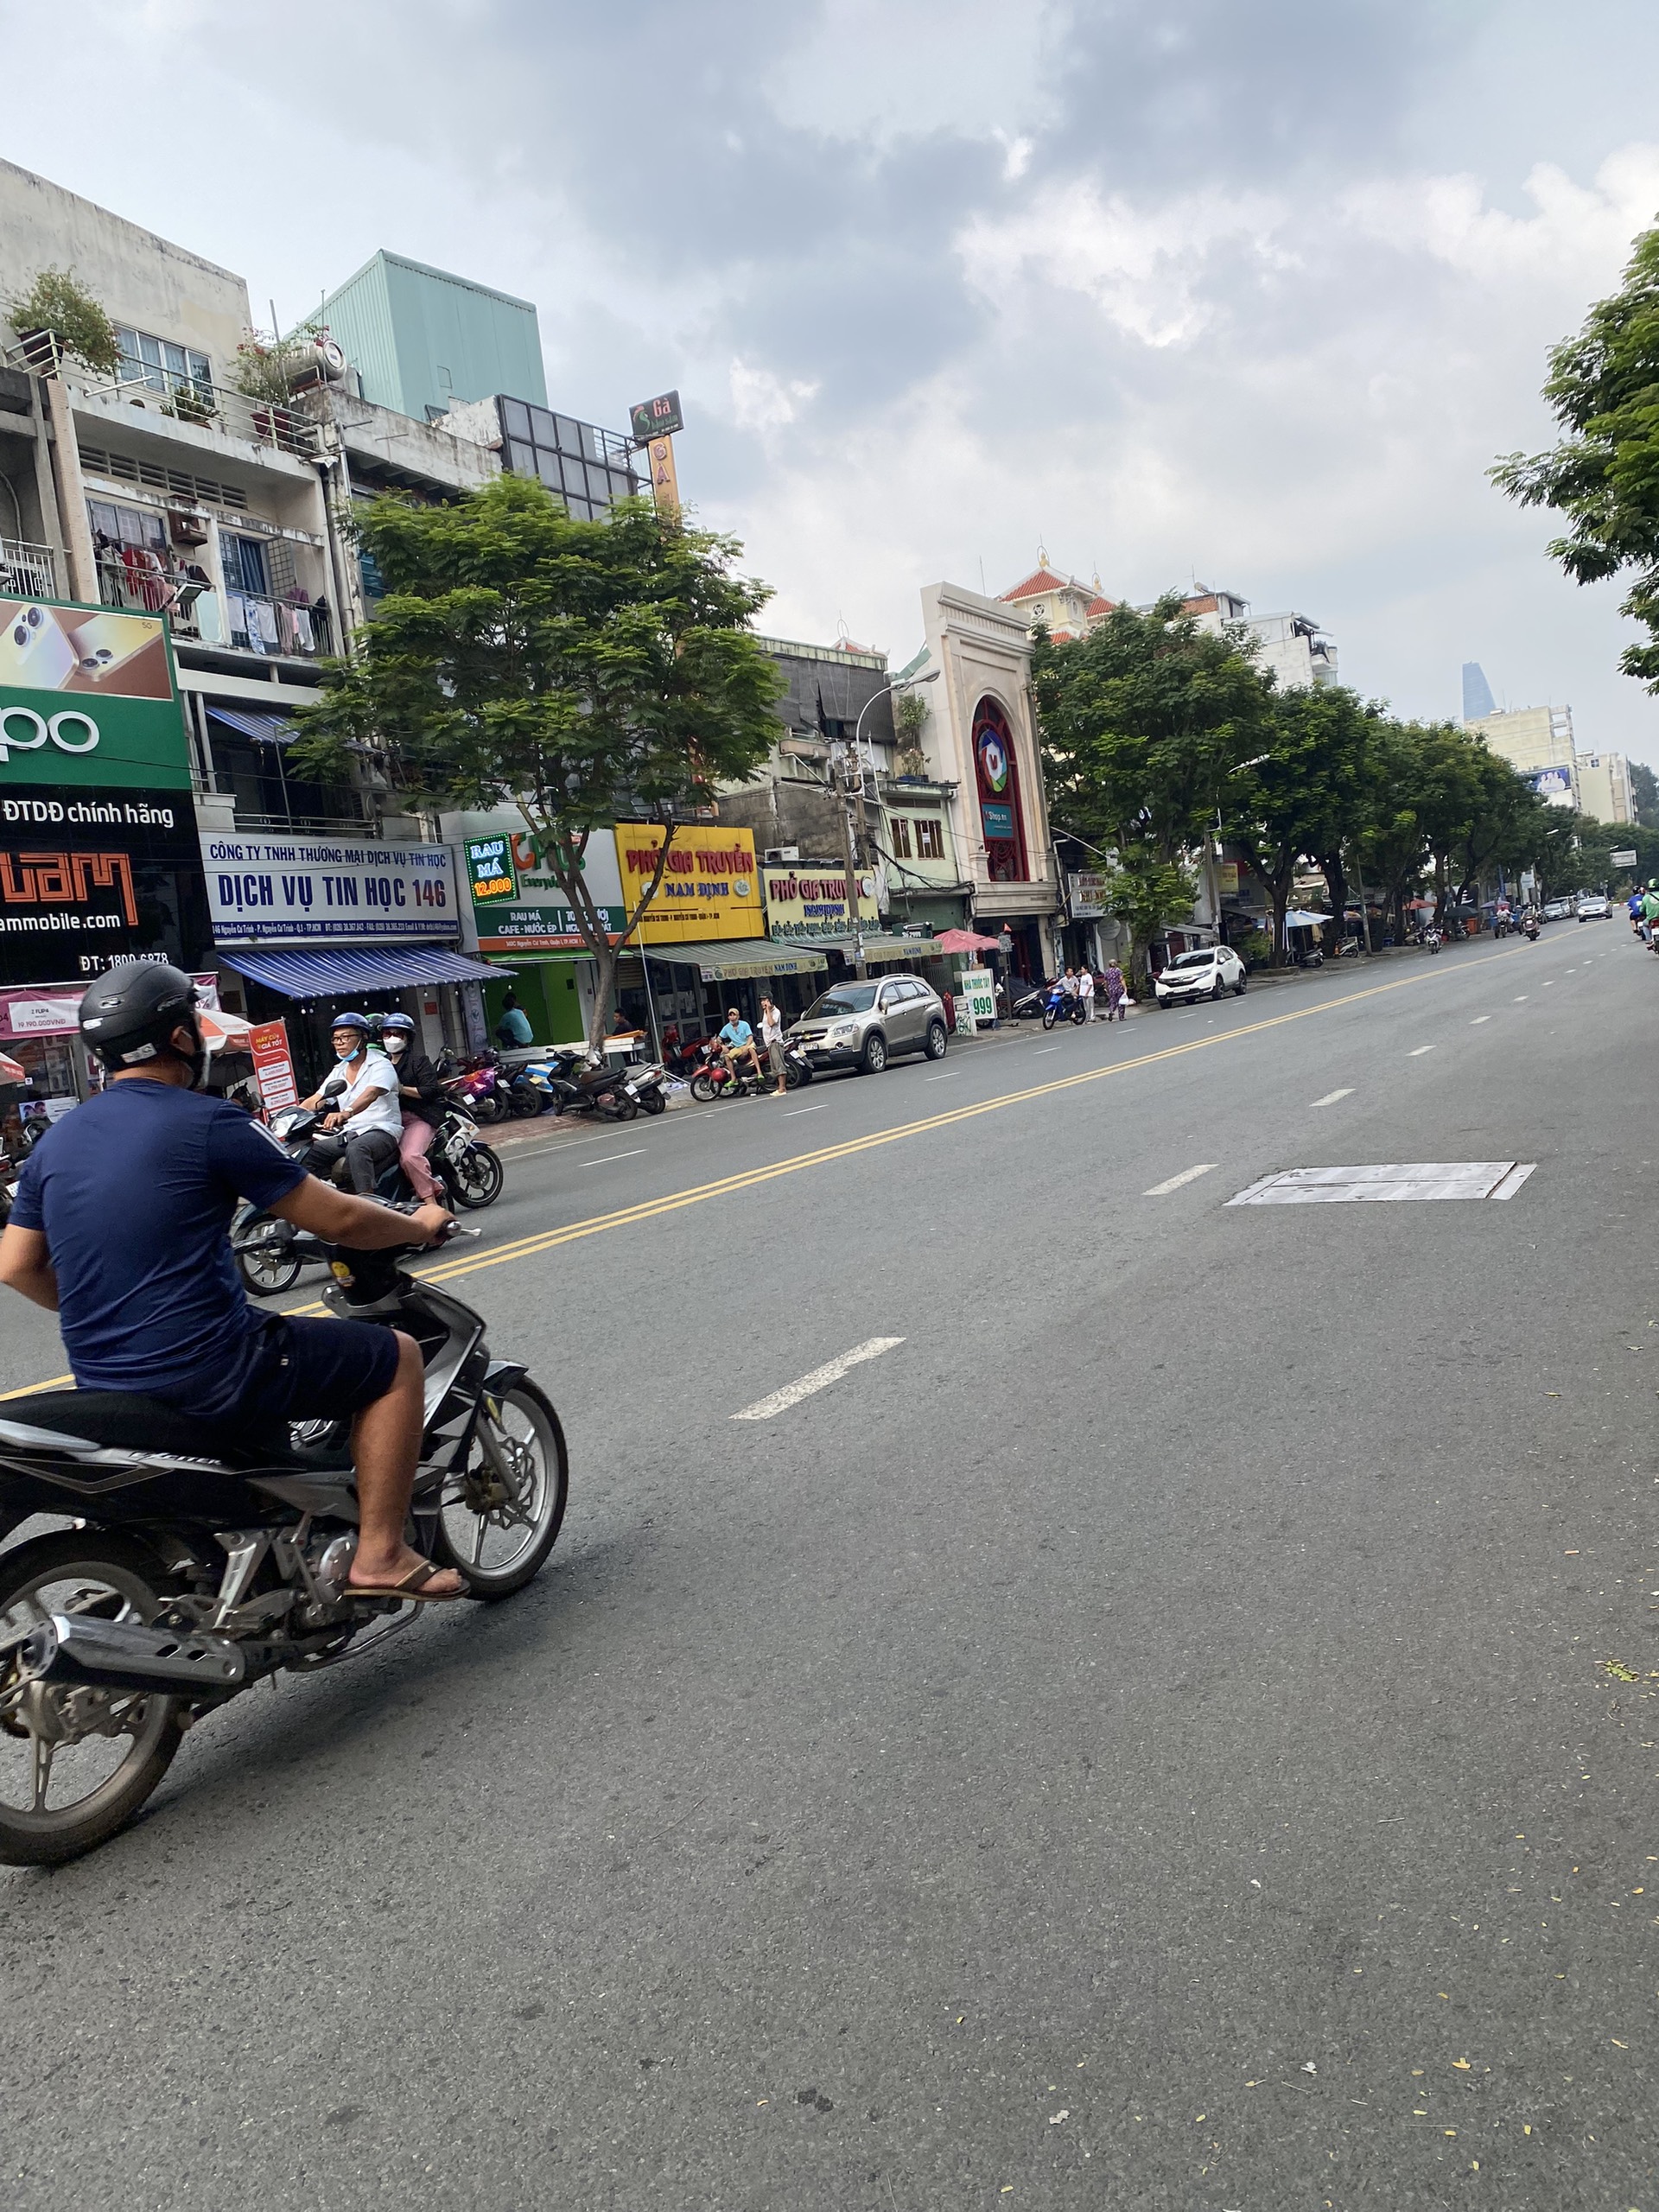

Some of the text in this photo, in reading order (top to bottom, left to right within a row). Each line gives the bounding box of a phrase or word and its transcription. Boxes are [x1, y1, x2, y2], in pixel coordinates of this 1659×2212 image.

[652, 397, 671, 417] Gà
[3, 800, 174, 829] ĐTDĐ chính hãng
[210, 841, 446, 869] CÔNG TY TNHH THƯƠNG MẠI DỊCH VỤ TIN HỌC
[471, 841, 504, 859] RAU
[666, 850, 694, 874] GIA
[696, 843, 753, 874] TRUYỀN
[476, 858, 504, 877] MÁ
[218, 874, 446, 912] DỊCH VỤ TIN HỌC 146
[474, 878, 512, 896] 12.000
[664, 882, 728, 900] NAM ĐỊNH
[771, 871, 798, 901] PHỞ
[799, 880, 820, 900] GIA
[510, 910, 542, 921] RAU MÁ
[804, 905, 825, 917] NAM
[499, 925, 520, 934] CAFE
[524, 924, 546, 933] NƯỚC
[547, 922, 557, 933] ÉP
[79, 956, 105, 970] ĐT:
[973, 996, 993, 1015] 999
